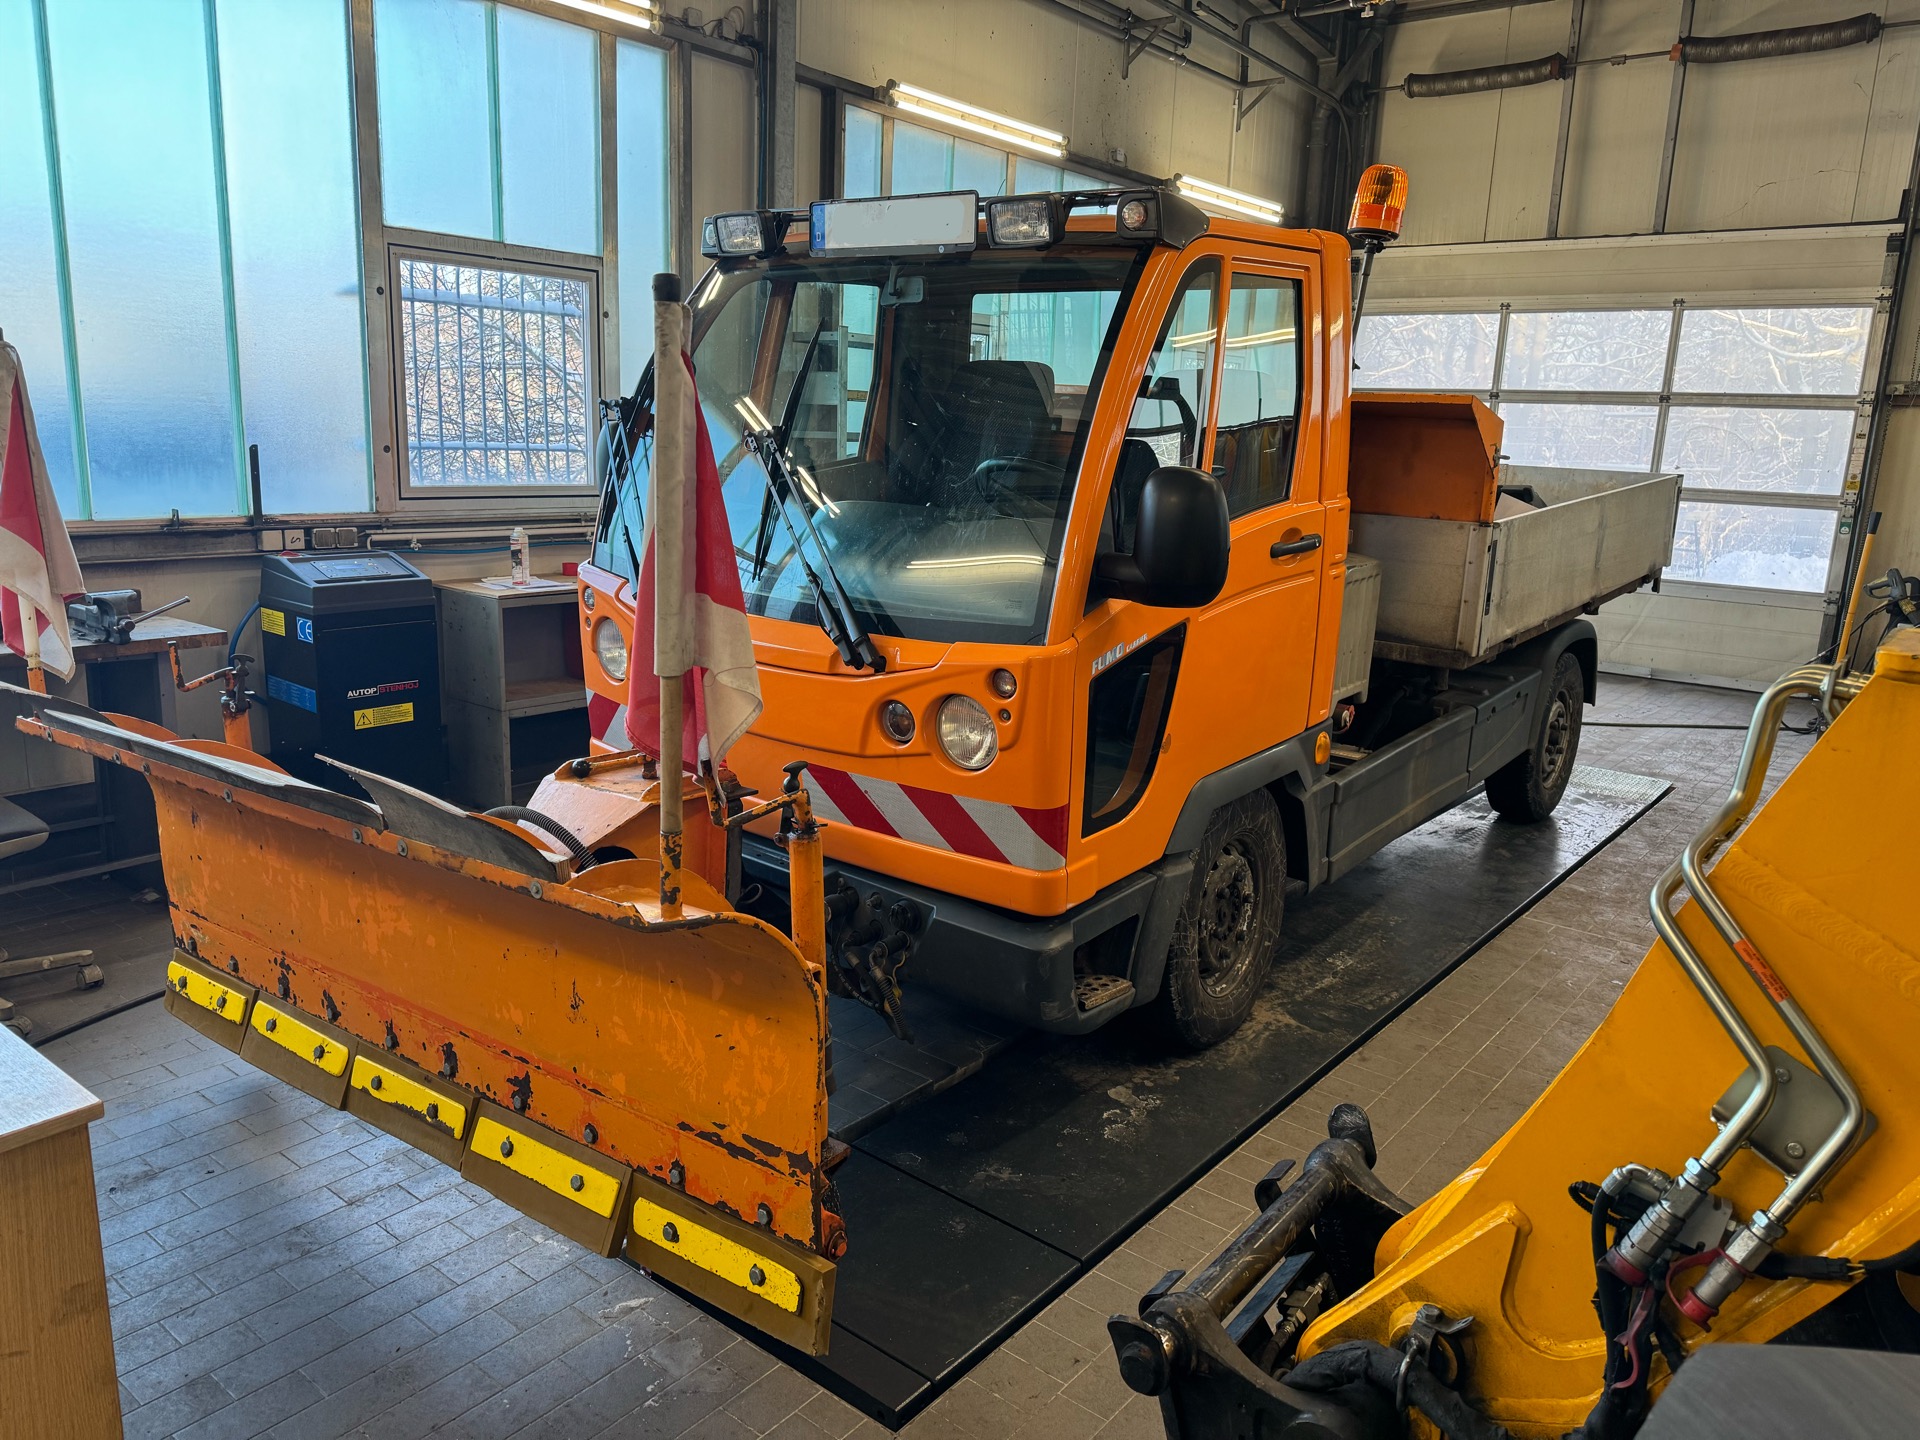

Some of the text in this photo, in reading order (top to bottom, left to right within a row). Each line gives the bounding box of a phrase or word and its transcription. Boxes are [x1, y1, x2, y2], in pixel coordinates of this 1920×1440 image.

[816, 231, 822, 242] D
[298, 620, 313, 641] CE
[1092, 642, 1125, 675] FUMO
[347, 687, 377, 697] AUTOP
